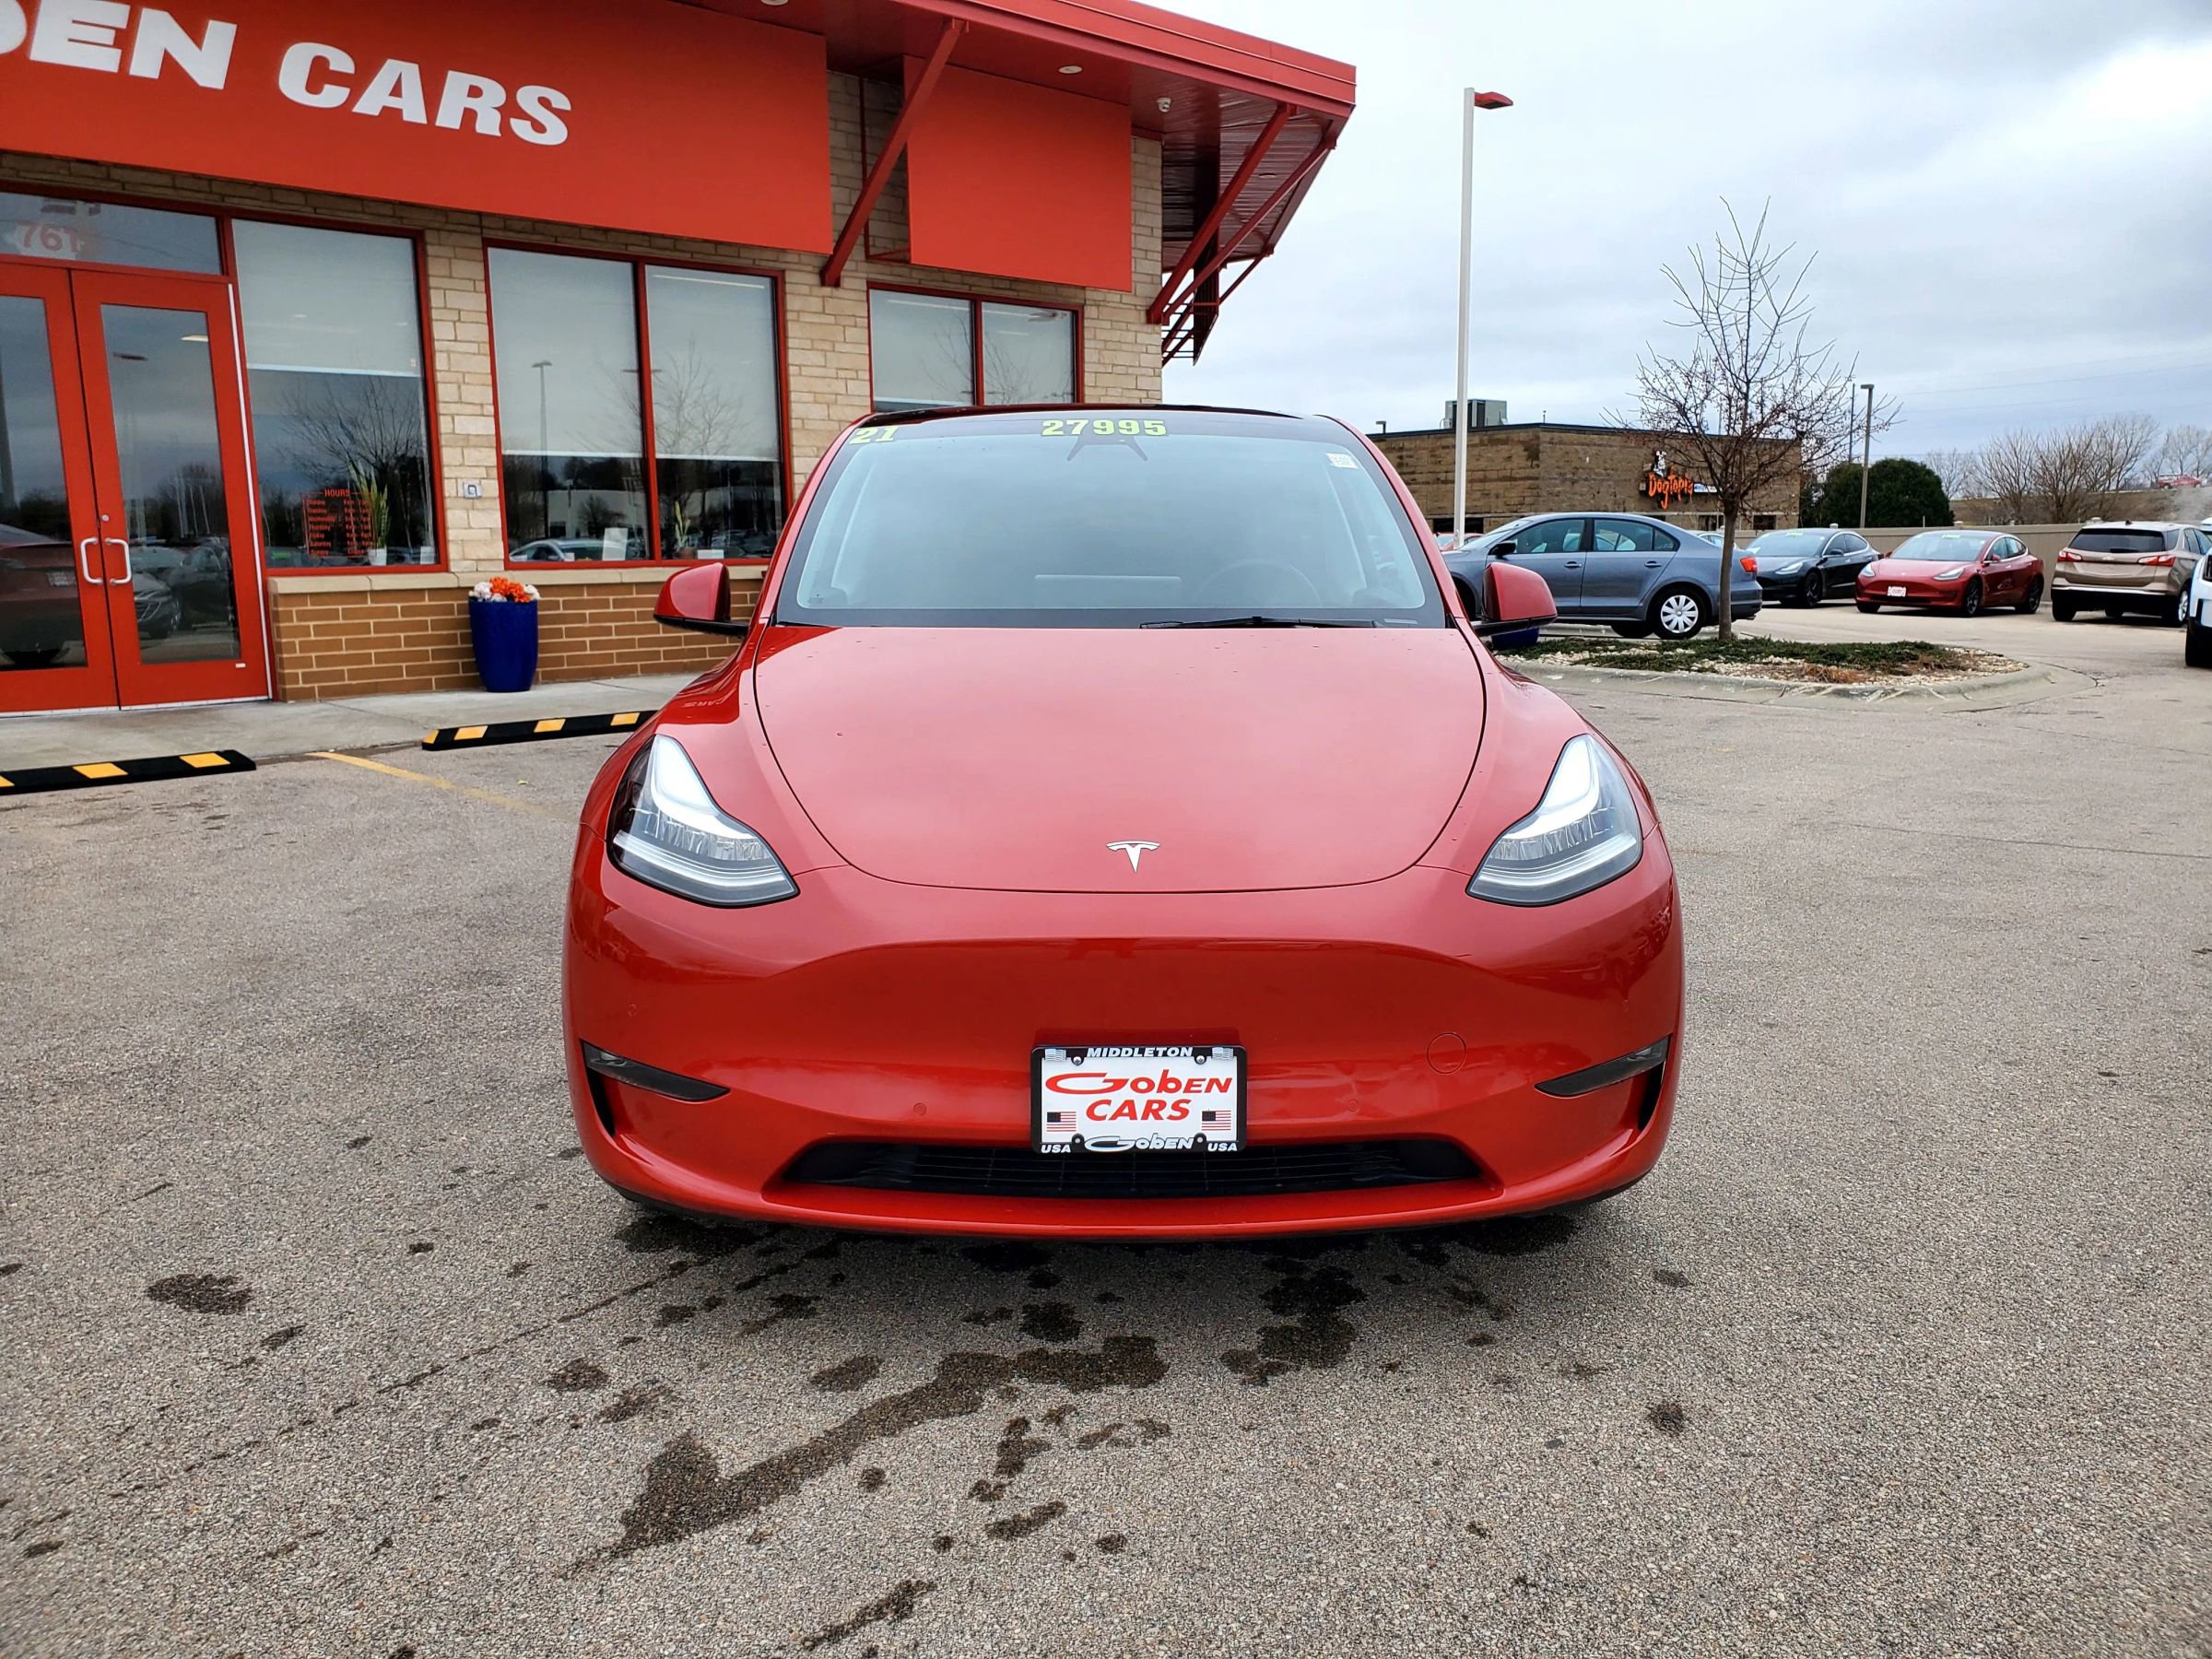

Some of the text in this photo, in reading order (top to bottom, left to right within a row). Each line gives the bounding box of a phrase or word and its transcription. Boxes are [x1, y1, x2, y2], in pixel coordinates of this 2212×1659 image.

[0, 0, 571, 146] EN CARS
[1041, 419, 1167, 436] 27995
[849, 426, 899, 444] 21
[324, 488, 350, 497] HOURS
[1087, 1047, 1194, 1057] MIDDLETON
[1086, 1099, 1192, 1121] CARS
[1041, 1144, 1071, 1153] USA
[1207, 1143, 1238, 1152] USA
